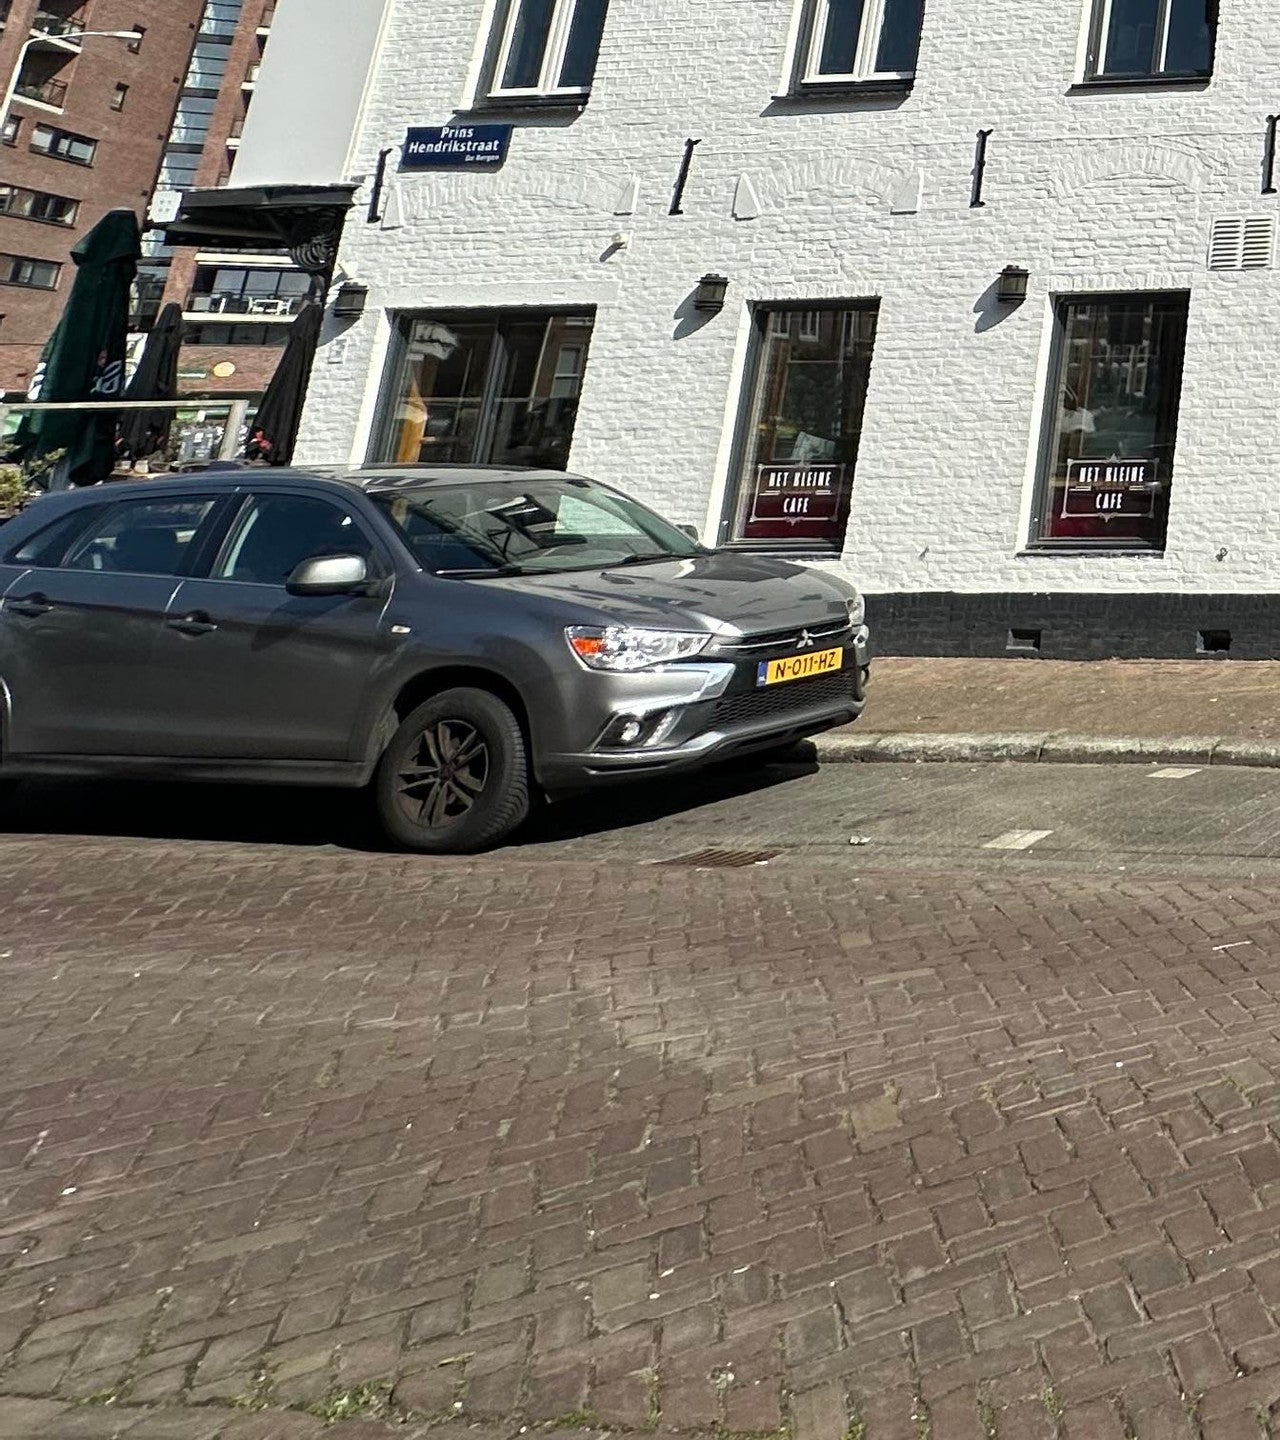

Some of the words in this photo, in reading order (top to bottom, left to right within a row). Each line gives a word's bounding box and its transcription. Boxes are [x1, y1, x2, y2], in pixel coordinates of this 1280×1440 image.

[440, 127, 475, 139] Prins
[408, 140, 500, 154] Hendrikstraat
[768, 471, 790, 487] HET
[793, 471, 832, 487] KLEINE
[1079, 466, 1100, 483] HET
[1105, 466, 1145, 482] KLEINE
[783, 497, 810, 513] CAFE
[1095, 492, 1123, 509] CAFE
[775, 651, 837, 680] N-011-HZ
